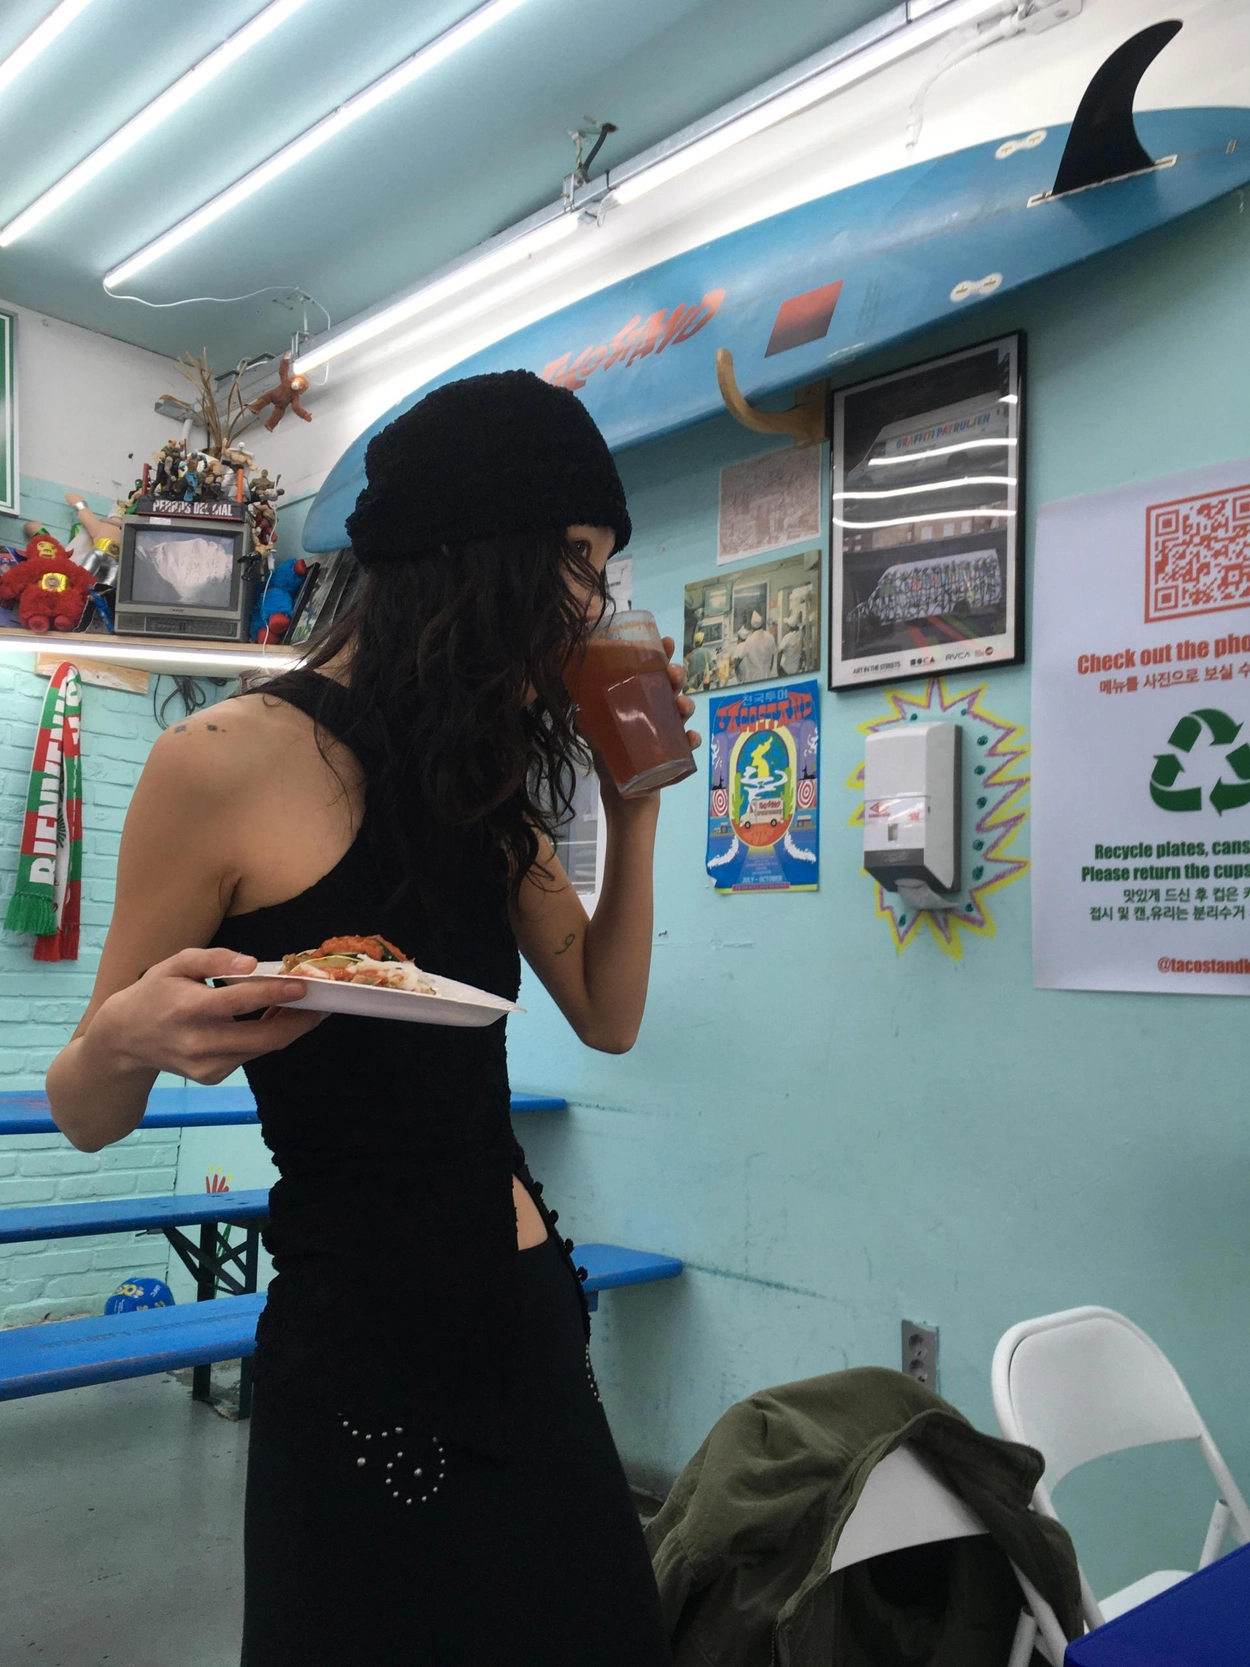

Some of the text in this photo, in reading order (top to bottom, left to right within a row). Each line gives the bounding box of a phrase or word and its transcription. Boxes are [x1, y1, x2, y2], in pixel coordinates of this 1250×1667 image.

[1077, 648, 1136, 675] Check
[1140, 643, 1173, 666] out
[1176, 639, 1210, 660] the
[1143, 667, 1200, 689] 사진으로
[1203, 662, 1234, 682] 보실
[1094, 841, 1153, 860] Recycle
[1156, 841, 1209, 858] plates,
[1081, 865, 1130, 882] Please
[1133, 864, 1181, 881] return
[1184, 862, 1210, 880] the
[1123, 887, 1160, 903] 맛있게
[1165, 887, 1190, 903] 드신
[1194, 887, 1208, 902] 후
[1212, 886, 1239, 902] 컵은
[1090, 906, 1113, 921] 접시
[1117, 906, 1129, 921] 및
[1193, 904, 1245, 921] 분리수거
